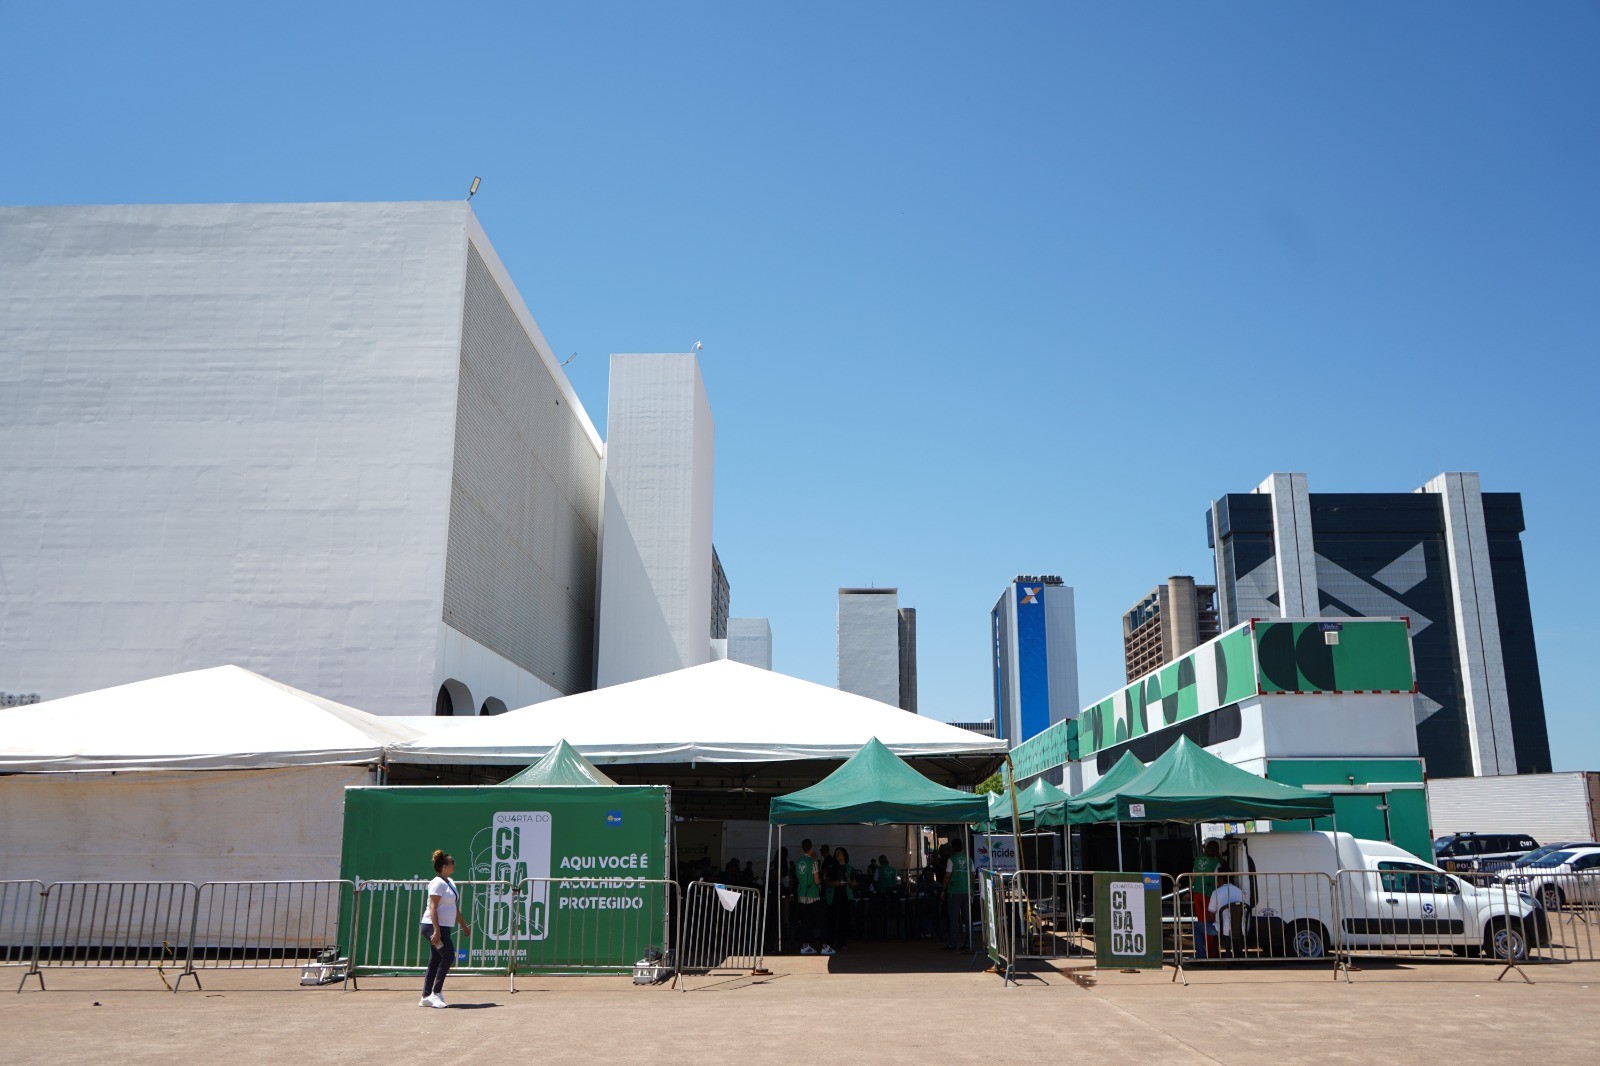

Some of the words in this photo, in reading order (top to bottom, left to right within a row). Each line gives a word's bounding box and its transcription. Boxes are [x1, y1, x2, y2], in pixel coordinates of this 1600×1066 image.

[497, 815, 533, 823] QU4RTA
[495, 827, 520, 860] CI
[560, 856, 596, 870] AQUI
[599, 854, 637, 868] VOCÊ
[640, 853, 648, 868] É
[559, 877, 634, 888] ACOLHIDO
[638, 877, 646, 888] E
[559, 897, 643, 909] PROTEGIDO
[1113, 890, 1127, 910] CI
[1113, 910, 1134, 930] DA
[1113, 930, 1144, 953] DÃO
